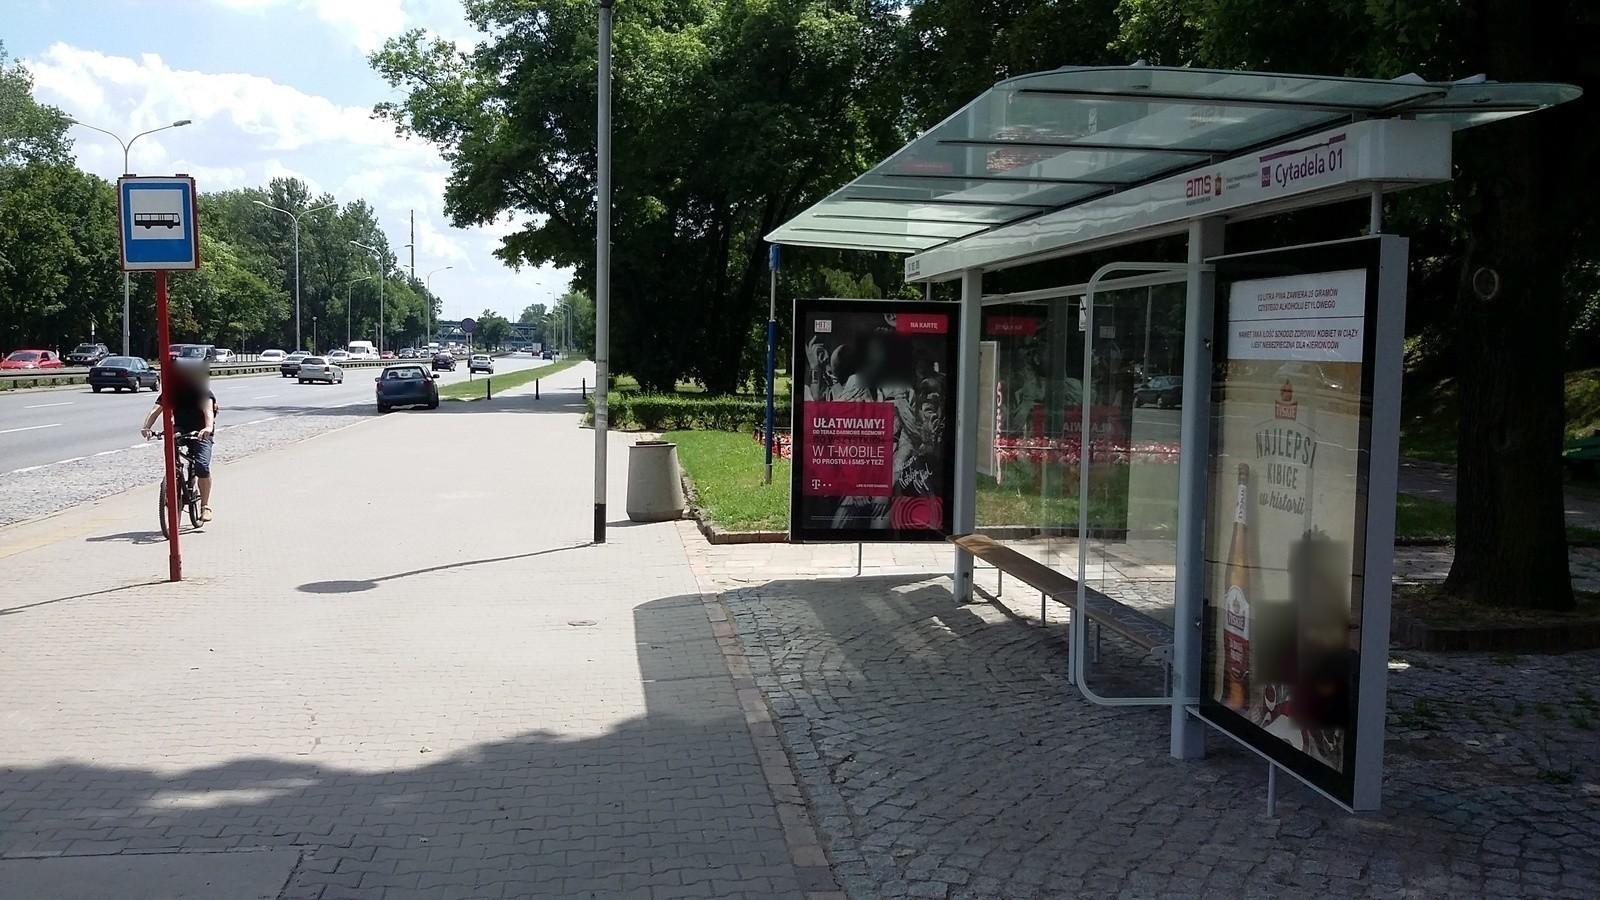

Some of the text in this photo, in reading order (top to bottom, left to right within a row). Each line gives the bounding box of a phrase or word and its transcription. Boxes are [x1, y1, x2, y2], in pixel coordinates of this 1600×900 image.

[1275, 155, 1325, 187] Cytadela
[1328, 148, 1344, 171] 01
[1186, 174, 1212, 198] ams
[1305, 300, 1336, 310] ETYLOWEGO
[813, 417, 885, 429] UŁATWIAMY!
[812, 445, 885, 458] W T-MOBILE
[1255, 428, 1318, 469] NAJLEPSI
[852, 458, 870, 466] SMS-Y
[1267, 462, 1299, 489] KIBICE
[1269, 490, 1305, 515] historii
